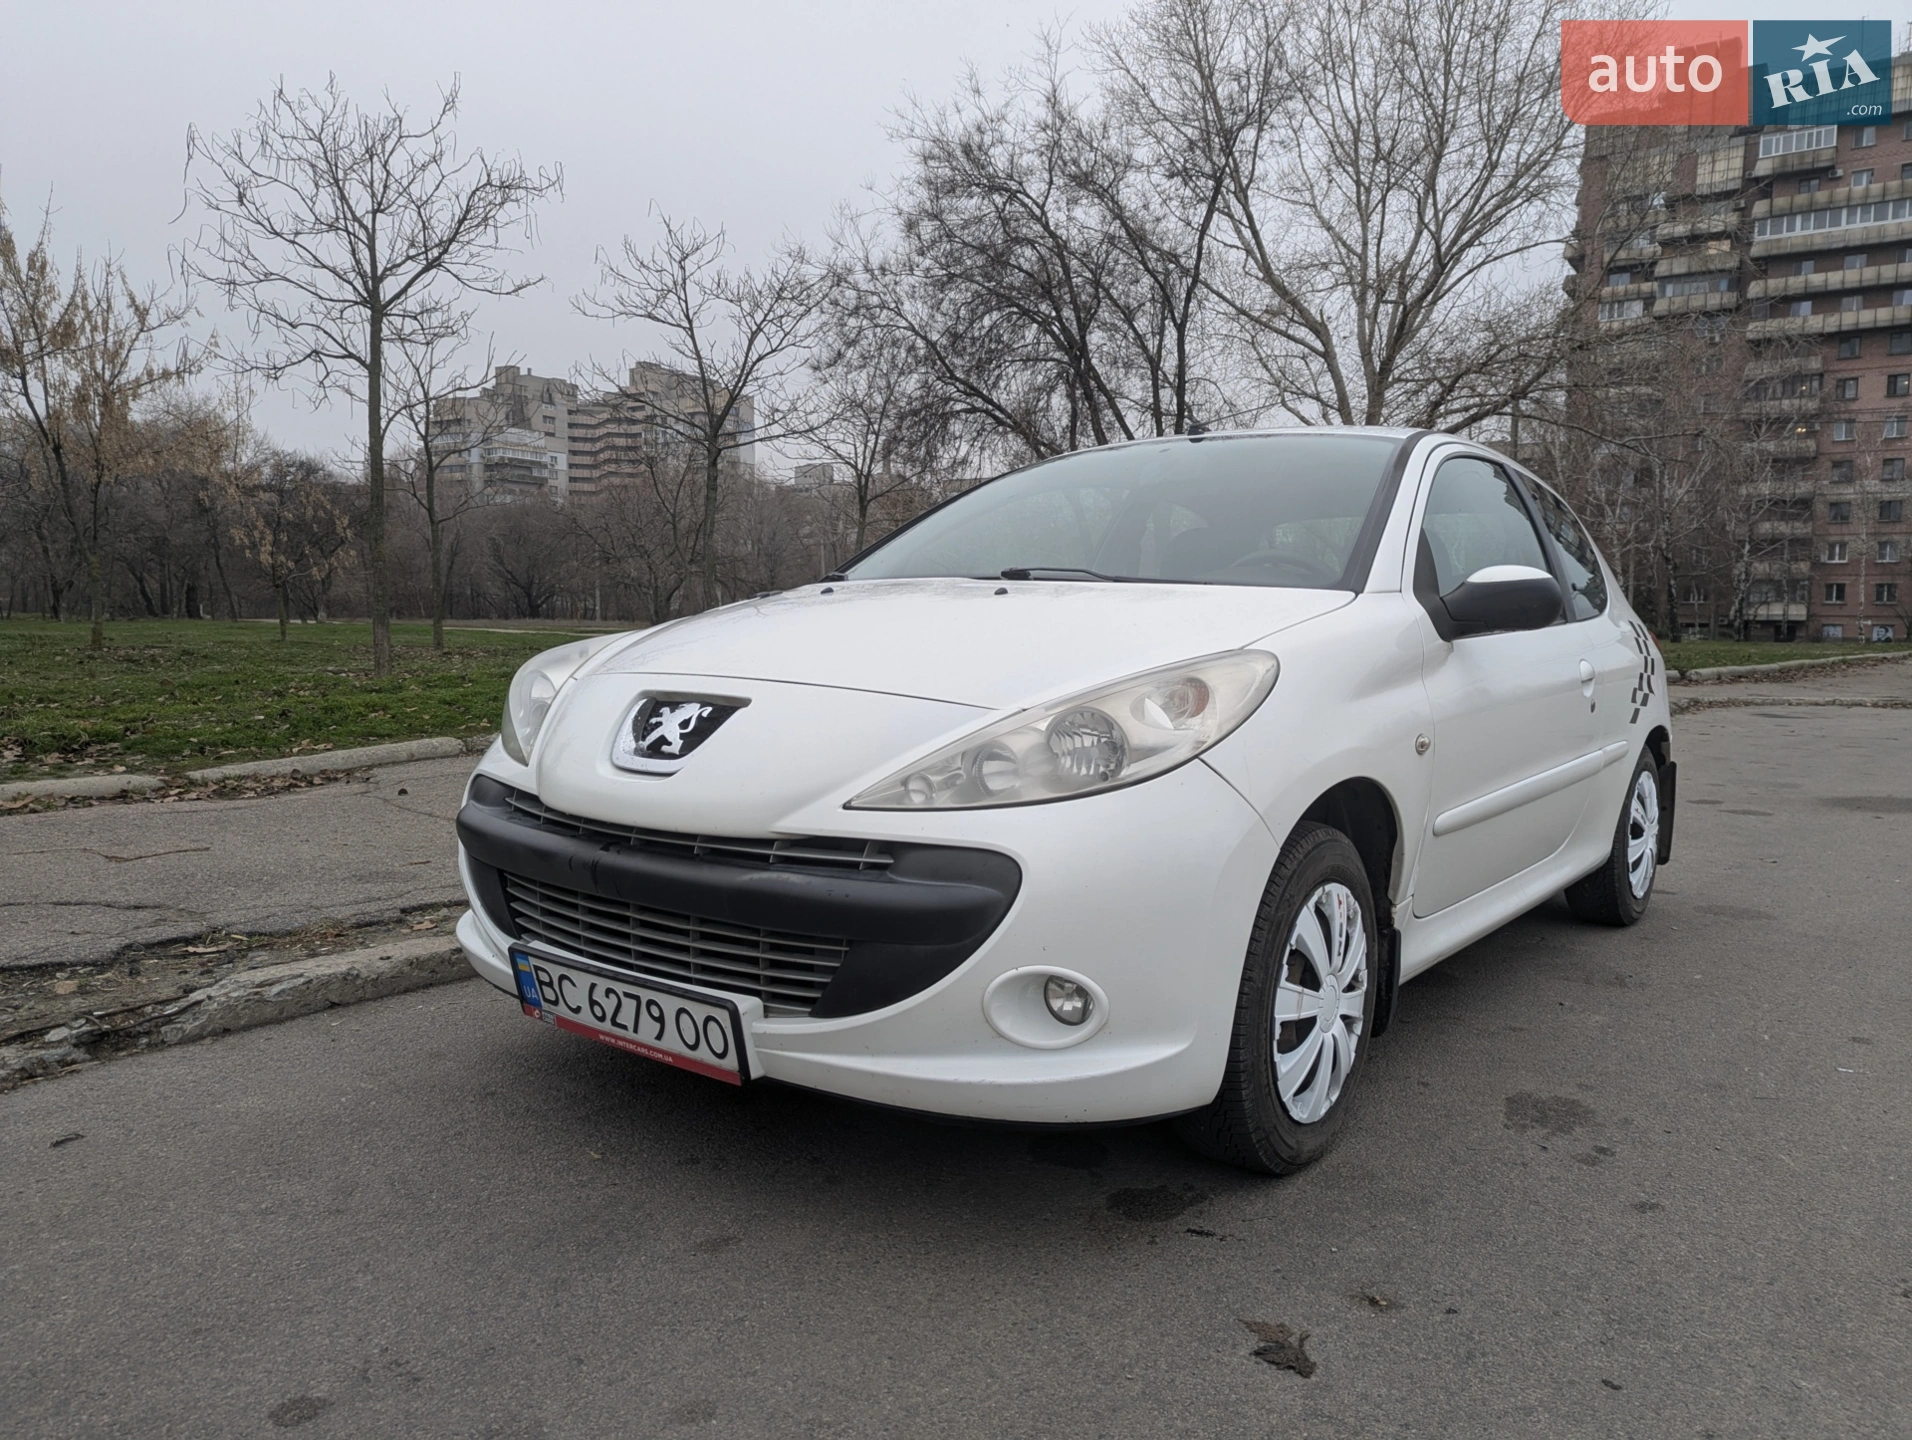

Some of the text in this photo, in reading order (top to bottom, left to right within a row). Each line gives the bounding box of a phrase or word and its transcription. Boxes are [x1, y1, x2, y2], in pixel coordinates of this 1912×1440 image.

[523, 985, 539, 1000] UA
[532, 963, 582, 1015] BC
[588, 982, 665, 1042] 6279
